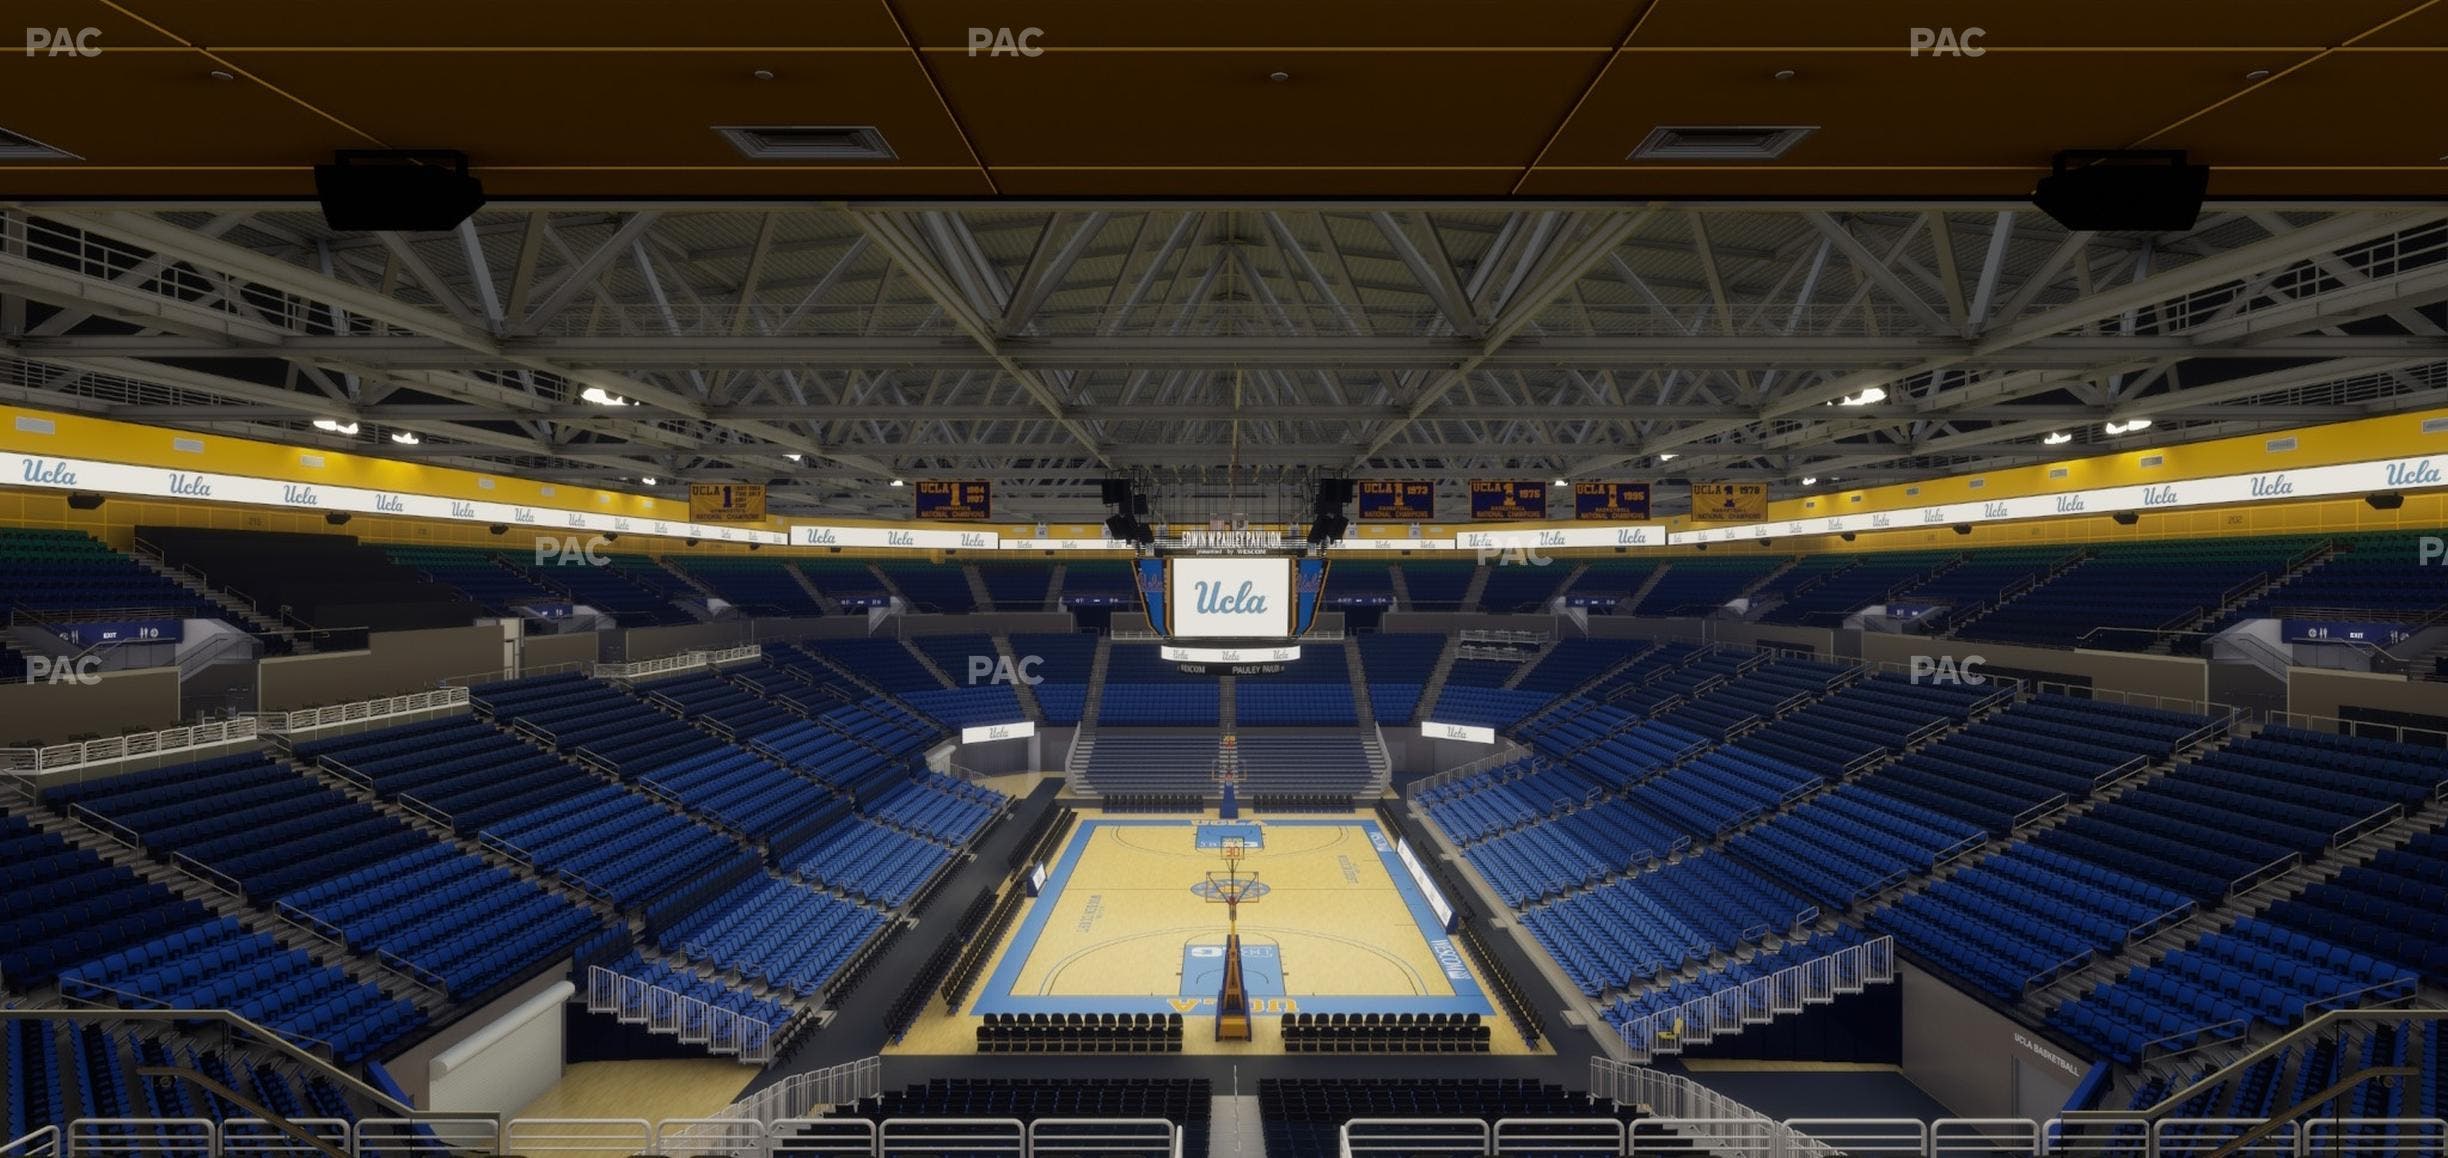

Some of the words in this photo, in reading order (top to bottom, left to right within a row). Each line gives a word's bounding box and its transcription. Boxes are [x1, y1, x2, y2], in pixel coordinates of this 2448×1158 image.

[22, 458, 77, 486] Ucla
[2385, 459, 2442, 487] Ucla
[169, 473, 212, 497] Ucla
[692, 486, 720, 496] UCLA
[920, 483, 949, 494] UCLA
[950, 483, 961, 506] 1
[1364, 483, 1393, 494] UCLA
[1393, 483, 1404, 506] 1
[1472, 482, 1502, 492] UCLA
[1503, 483, 1516, 506] 1
[2250, 474, 2294, 497] Ucla
[283, 484, 318, 506] Ucla
[376, 494, 404, 513] Ucla
[1576, 484, 1605, 495] UCLA
[1608, 484, 1618, 508] 1
[1694, 485, 1722, 495] UCLA
[1724, 485, 1735, 508] 1
[2056, 494, 2085, 513] Ucla
[2143, 485, 2178, 506] Ucla
[451, 501, 475, 519] Ucla
[514, 508, 535, 523] Ucla
[1924, 507, 1944, 523] Ucla
[1984, 501, 2008, 518] Ucla
[1873, 514, 1890, 528] Ucla
[807, 528, 837, 545] Ucla
[887, 531, 914, 546] Ucla
[960, 533, 985, 547] Ucla
[1182, 531, 1207, 548] EDWIN
[1216, 531, 1245, 548] PAULEY
[1246, 531, 1281, 548] PAVILION
[1469, 533, 1493, 547] Ucla
[1539, 531, 1566, 546] Ucla
[1617, 528, 1647, 545] Ucla
[1194, 580, 1268, 615] Ucla
[1231, 665, 1260, 675] PAULEY
[2014, 1032, 2033, 1050] UCLA
[2033, 1043, 2080, 1077] BASKETBALL
